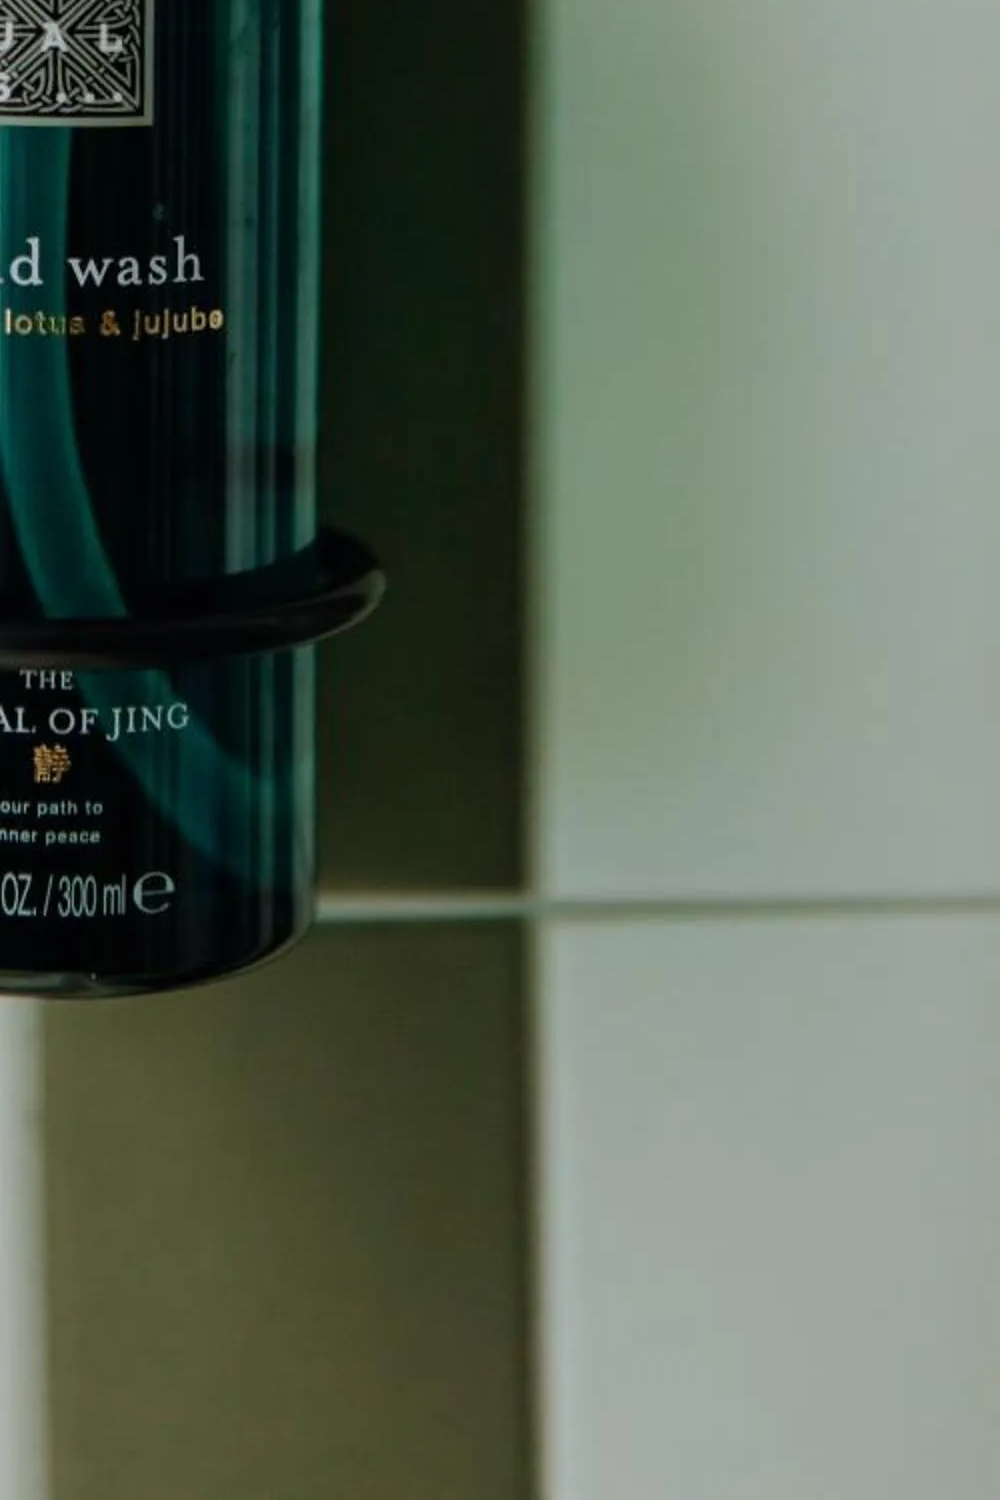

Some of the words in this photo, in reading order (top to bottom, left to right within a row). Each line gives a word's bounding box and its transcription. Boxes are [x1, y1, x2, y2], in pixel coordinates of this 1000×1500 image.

[67, 235, 205, 287] wash
[4, 308, 86, 336] lotus
[100, 310, 121, 336] &
[132, 308, 225, 342] jujube
[19, 670, 74, 691] THE
[49, 708, 99, 735] OF
[105, 703, 190, 742] JING
[37, 801, 79, 817] path
[85, 801, 104, 816] to
[45, 828, 102, 846] peace
[58, 874, 97, 917] 300
